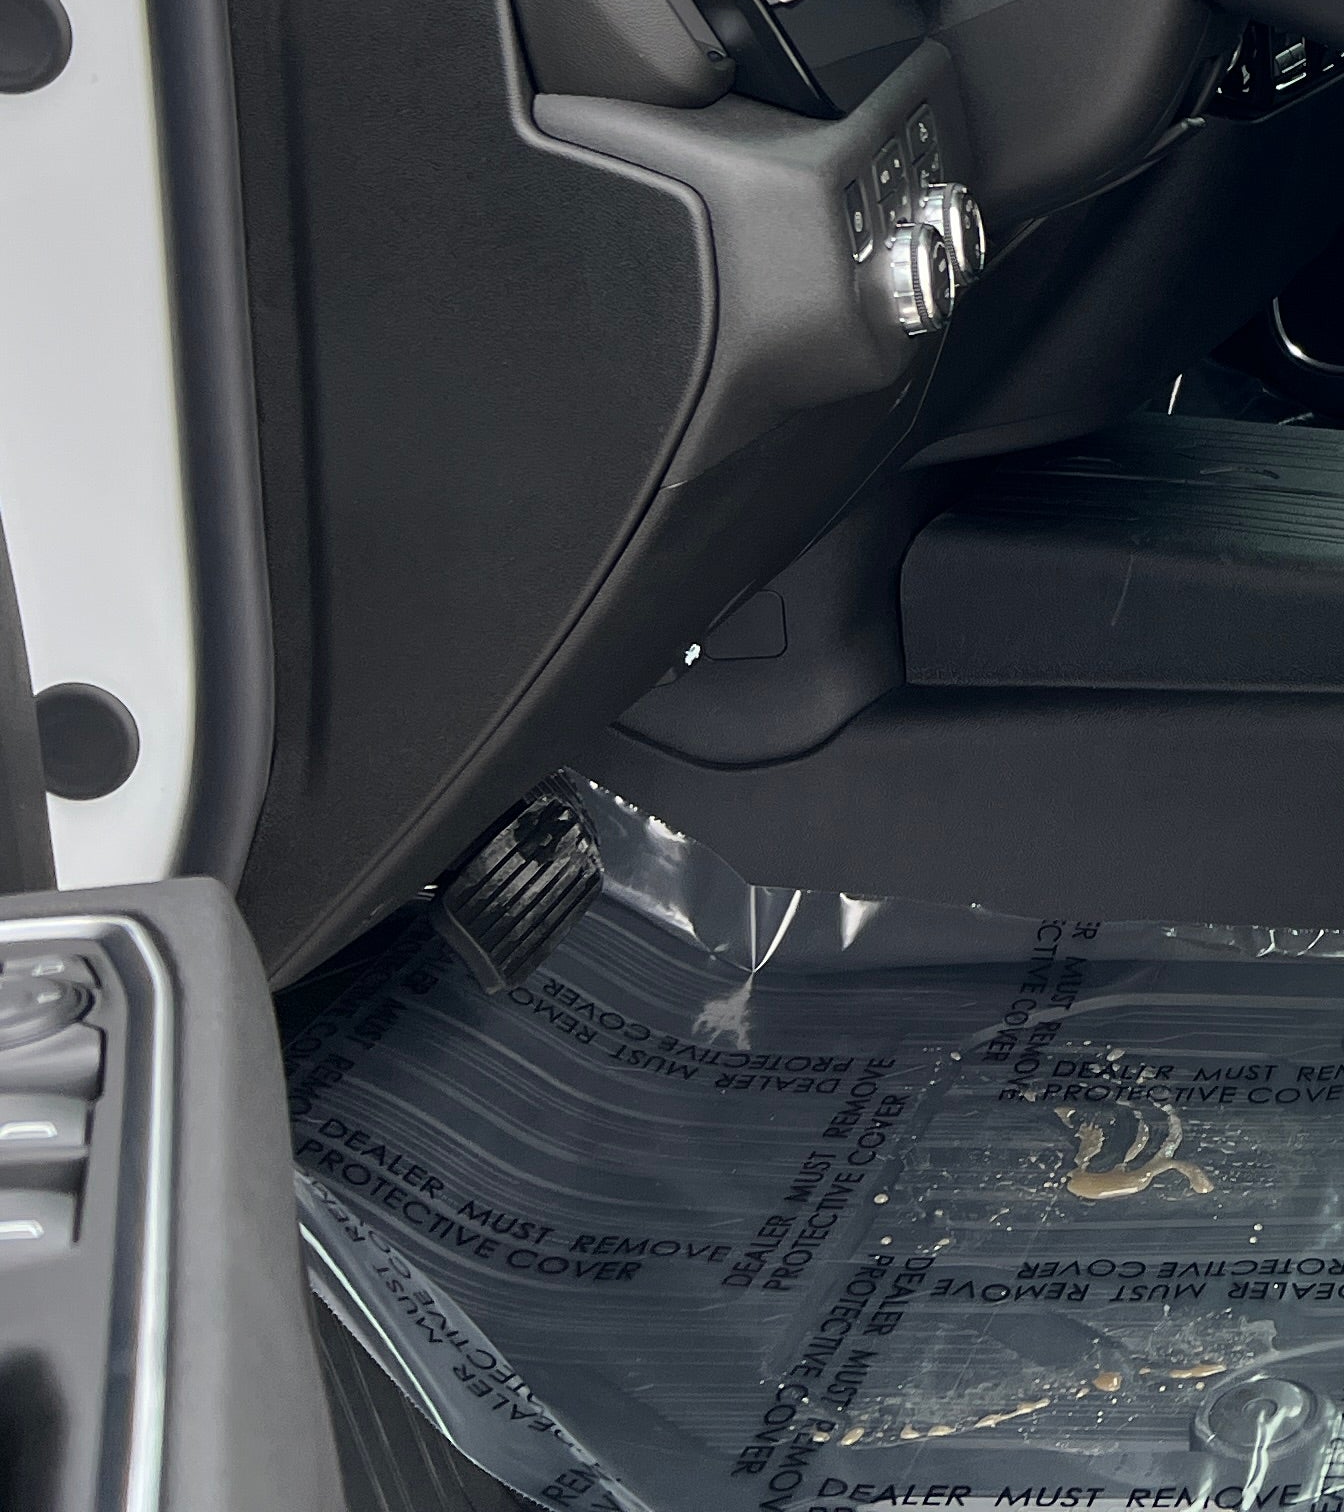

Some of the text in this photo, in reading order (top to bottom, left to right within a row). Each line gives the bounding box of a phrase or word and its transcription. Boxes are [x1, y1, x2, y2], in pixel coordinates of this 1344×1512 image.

[609, 1042, 702, 1080] MUST
[981, 999, 1033, 1064] COVER
[713, 1067, 840, 1096] DEALER
[1192, 1062, 1279, 1082] MUST
[318, 1117, 733, 1264] DEALER MUST REMOVE
[721, 1056, 896, 1290] DEALER MUST REMOVE
[762, 1092, 907, 1293] PROTECTIVE COVER
[296, 1139, 496, 1259] PROTECTIVE
[505, 1245, 643, 1283] COVER
[862, 1255, 938, 1337] DEALER
[932, 1277, 1089, 1304] REMOVE
[1017, 1258, 1146, 1279] COVER
[1108, 1281, 1206, 1303] MUST
[372, 1264, 444, 1345] MUST
[788, 1252, 896, 1386] PROTECTIVE
[822, 1347, 880, 1411] MUST
[816, 1476, 1300, 1509] DEALER MUST REMOVE
